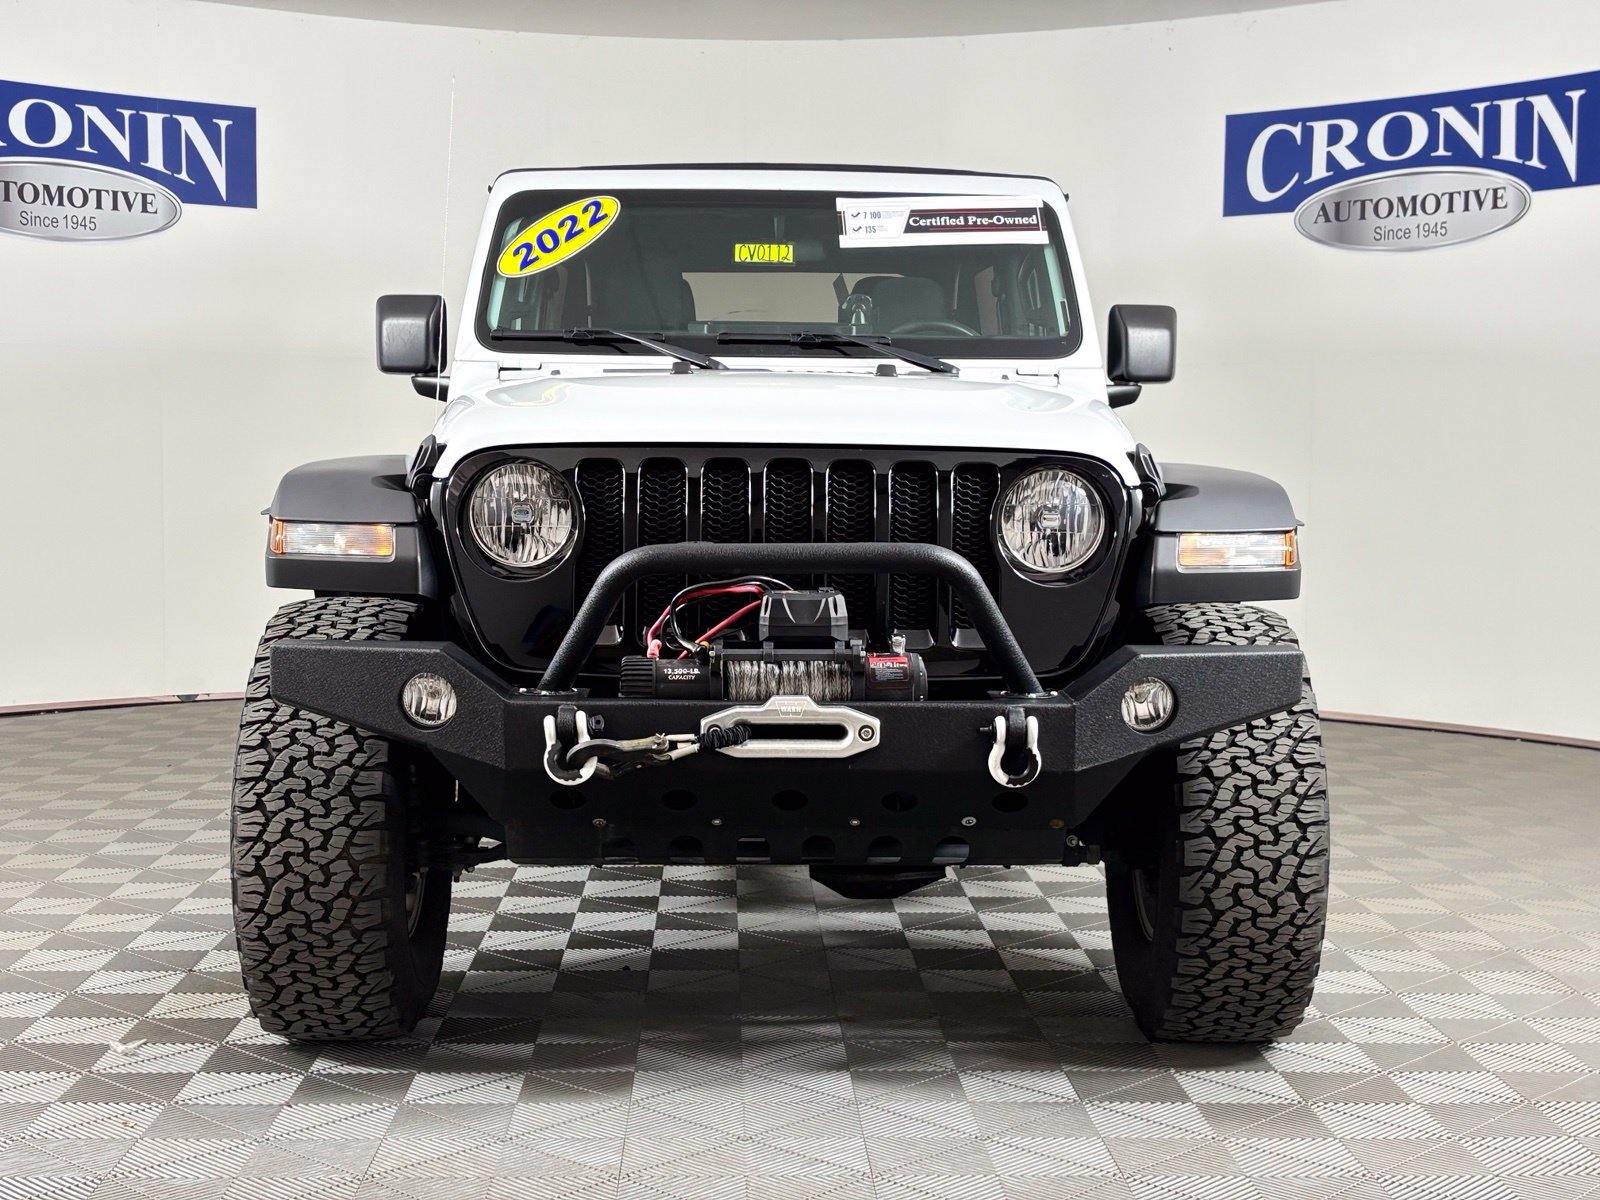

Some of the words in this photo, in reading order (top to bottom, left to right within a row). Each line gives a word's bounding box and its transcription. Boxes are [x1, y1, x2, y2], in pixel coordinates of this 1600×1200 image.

[0, 98, 233, 202] ONIN
[1246, 88, 1587, 203] CRONIN
[19, 210, 59, 228] Since
[62, 213, 97, 231] 1945
[909, 215, 964, 226] Certified
[967, 214, 1038, 225] Pre-Owned
[1313, 186, 1509, 224] AUTOMOTIVE
[513, 200, 609, 271] 2022
[1373, 225, 1412, 242] Since
[1415, 220, 1448, 239] 1945
